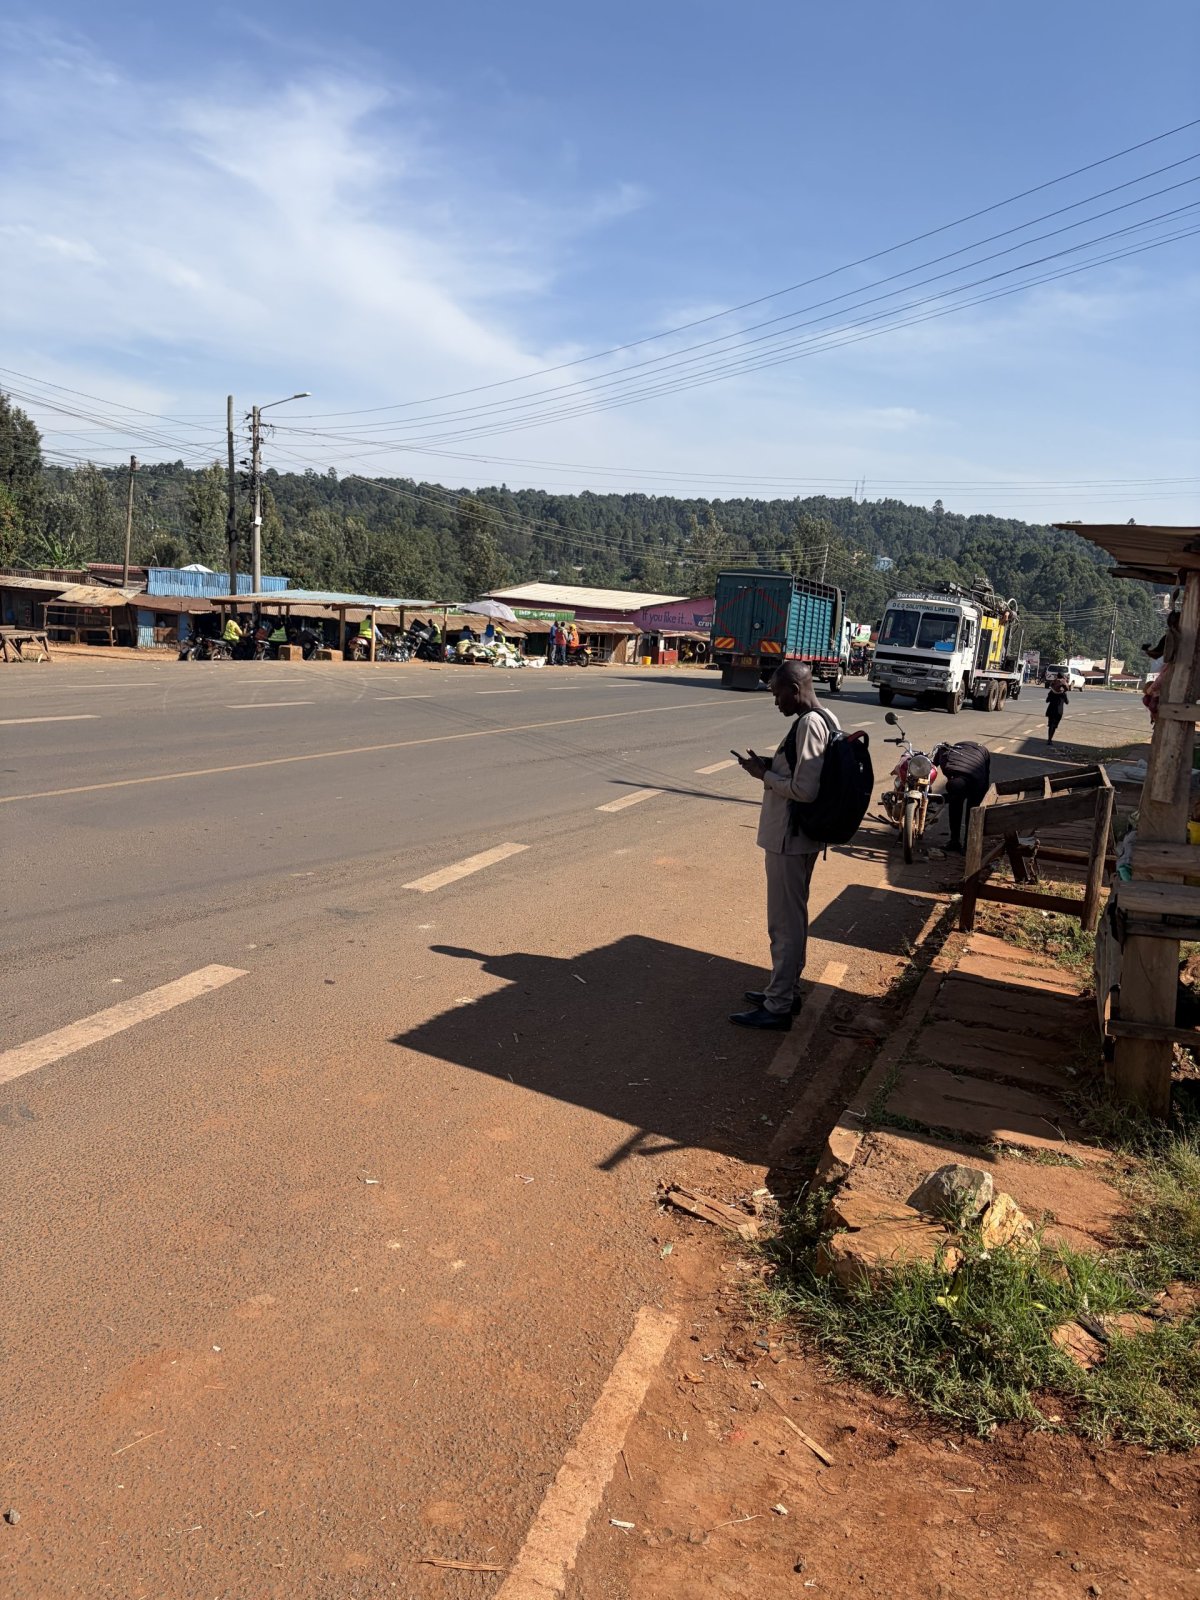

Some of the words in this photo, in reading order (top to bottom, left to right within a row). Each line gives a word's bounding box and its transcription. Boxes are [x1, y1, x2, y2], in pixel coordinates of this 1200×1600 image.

[928, 593, 959, 602] Services
[642, 610, 648, 621] If
[649, 614, 662, 623] you
[664, 611, 676, 623] like
